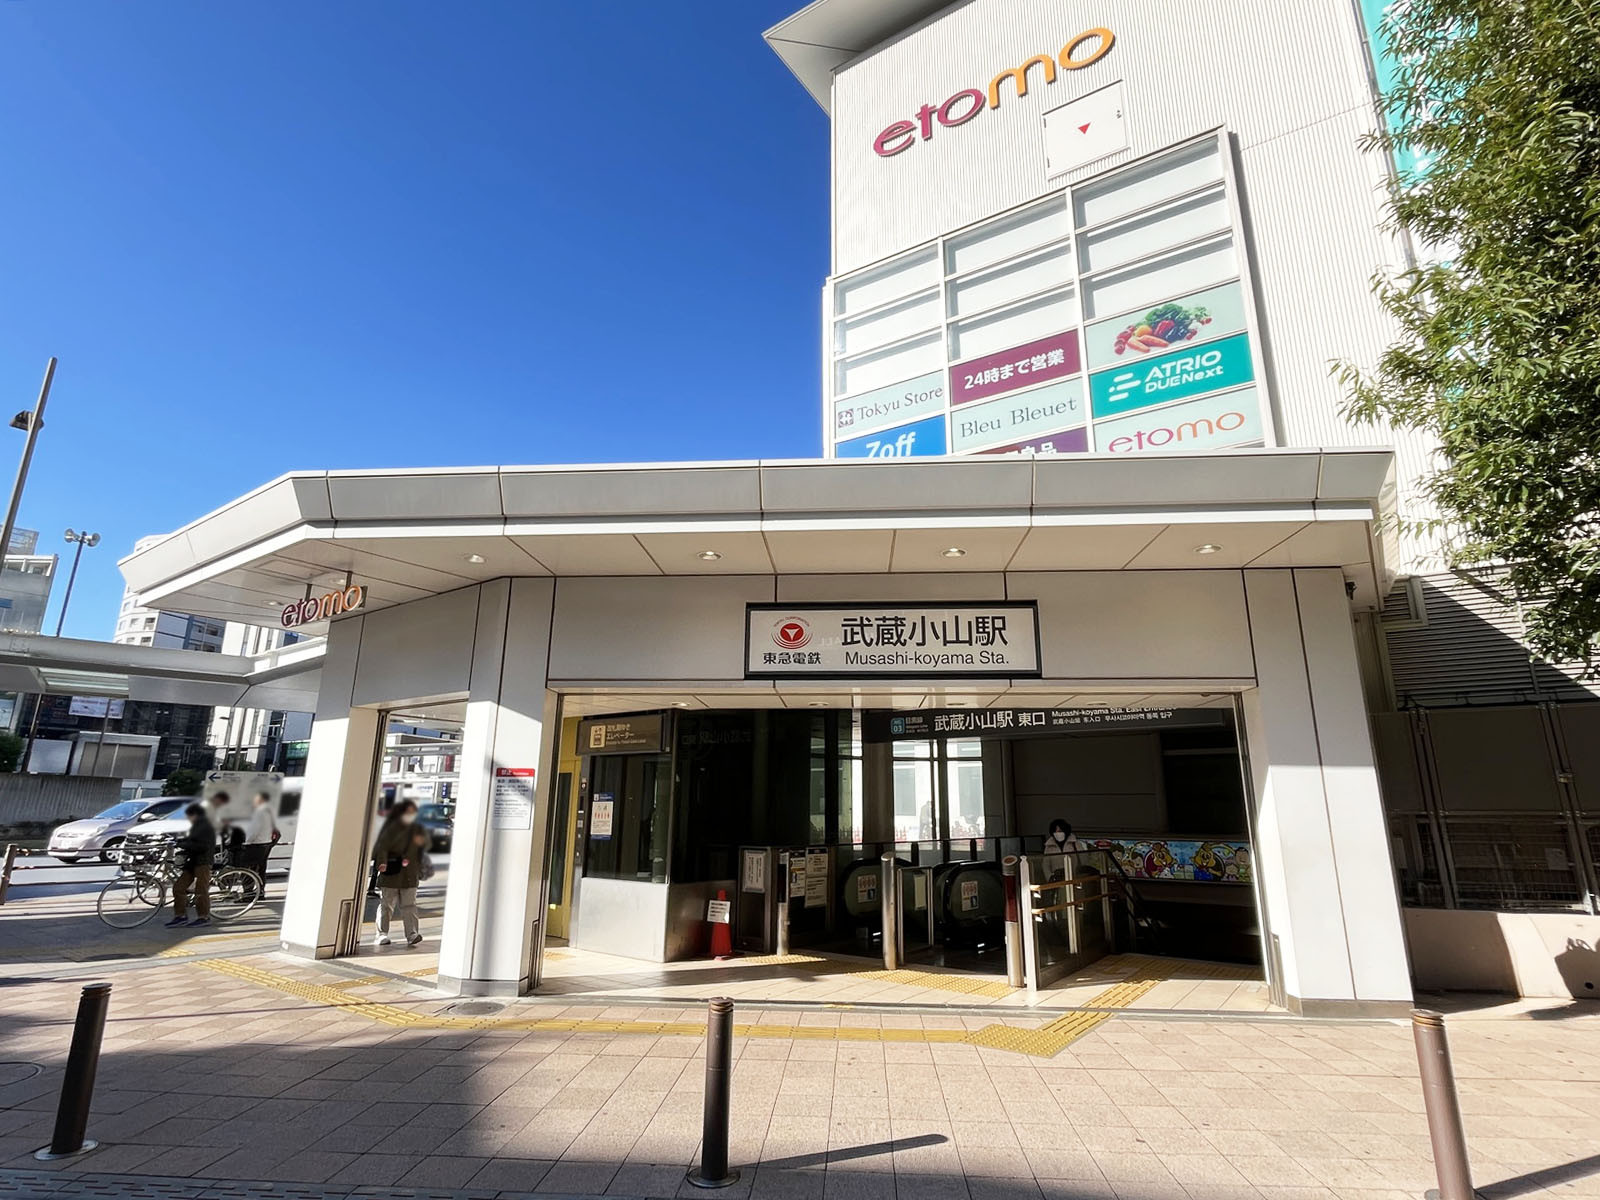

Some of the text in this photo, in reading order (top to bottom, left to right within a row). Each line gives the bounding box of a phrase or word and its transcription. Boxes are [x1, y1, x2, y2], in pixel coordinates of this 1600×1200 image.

[873, 27, 1116, 158] etomo
[963, 349, 1066, 390] 24時まで営業
[1144, 351, 1222, 380] ATRIO
[857, 387, 943, 421] Tokyu Store
[960, 399, 1078, 439] Bleu Bleuet
[866, 431, 918, 457] Zoff
[1109, 411, 1246, 453] etomo
[281, 585, 363, 628] etomo
[841, 615, 1009, 648] 武蔵小山駅
[763, 652, 822, 665] 東急電鉄
[845, 650, 1009, 668] Musashi-koyama Sta.
[934, 711, 1014, 732] 武蔵小山駅
[1018, 711, 1046, 727] 東口
[1051, 709, 1109, 717] Musashi-koyama
